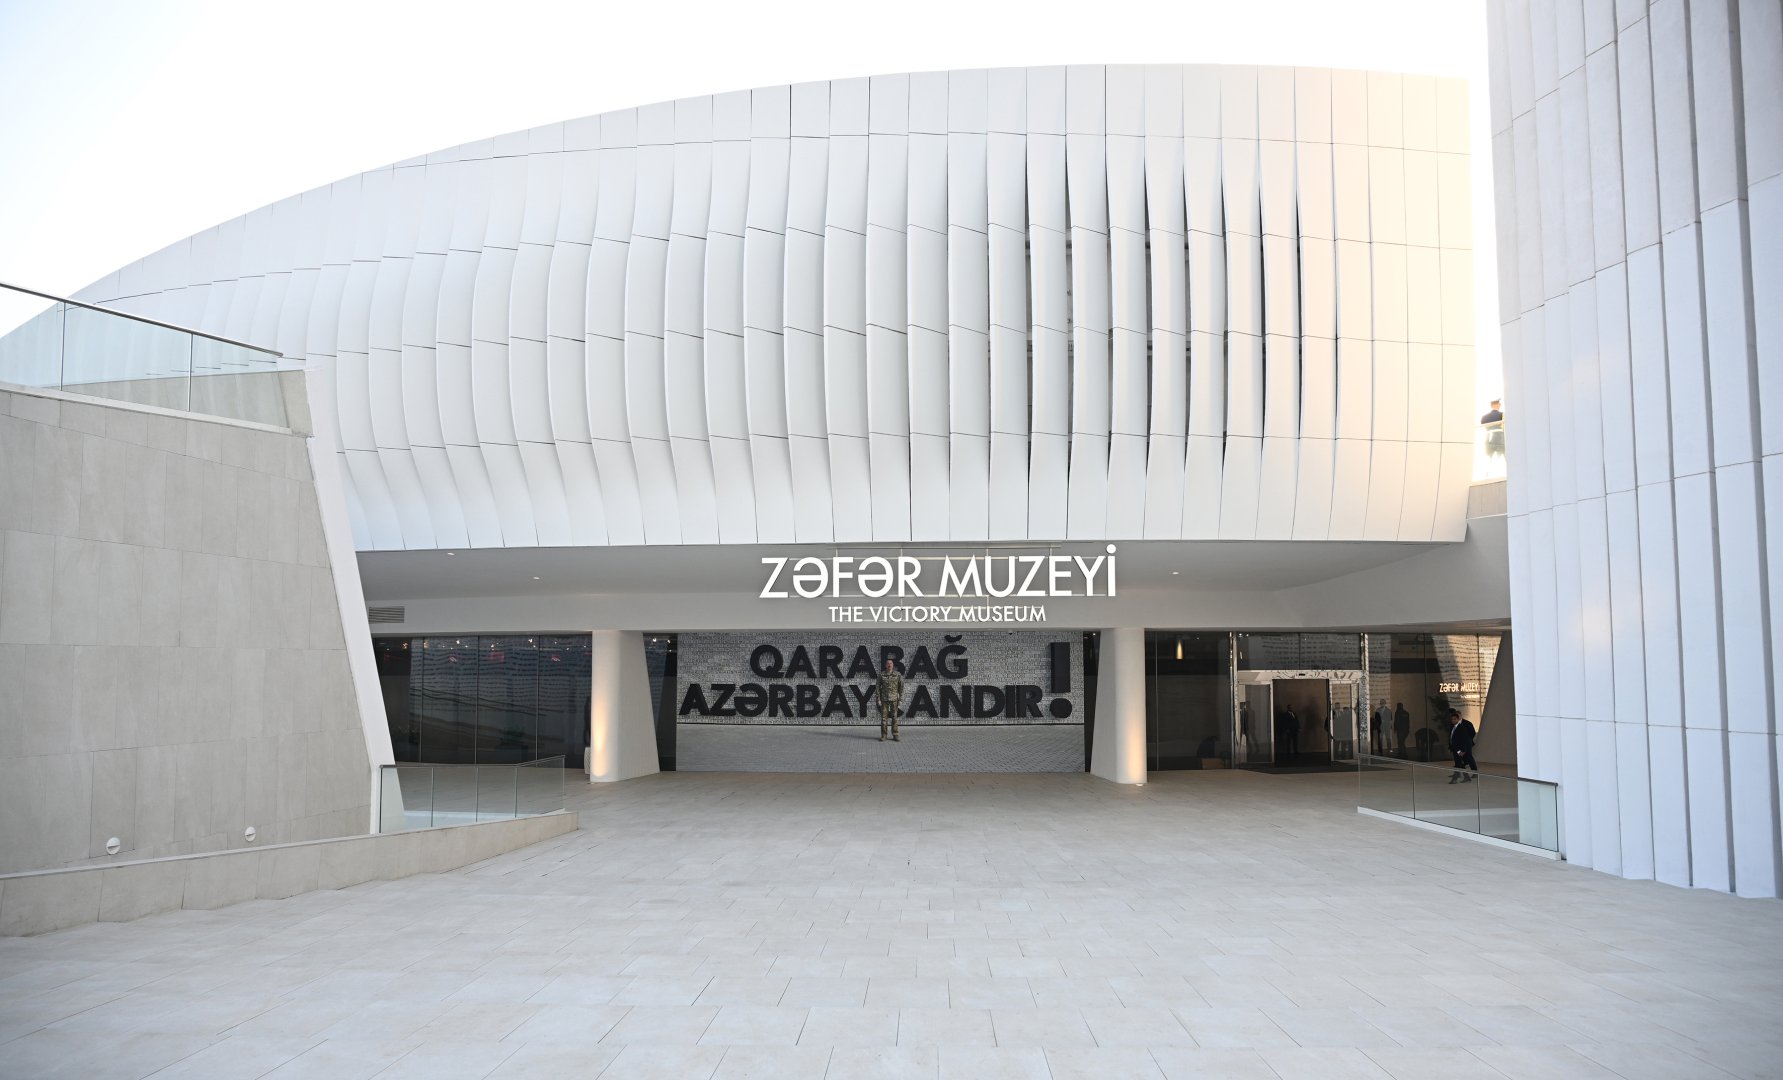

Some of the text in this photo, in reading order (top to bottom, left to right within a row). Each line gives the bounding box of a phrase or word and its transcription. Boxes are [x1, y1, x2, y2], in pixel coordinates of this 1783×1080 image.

[760, 544, 1117, 599] ZƏFƏR MUZEYİ
[828, 605, 1047, 622] THE VICTORY MUSEUM
